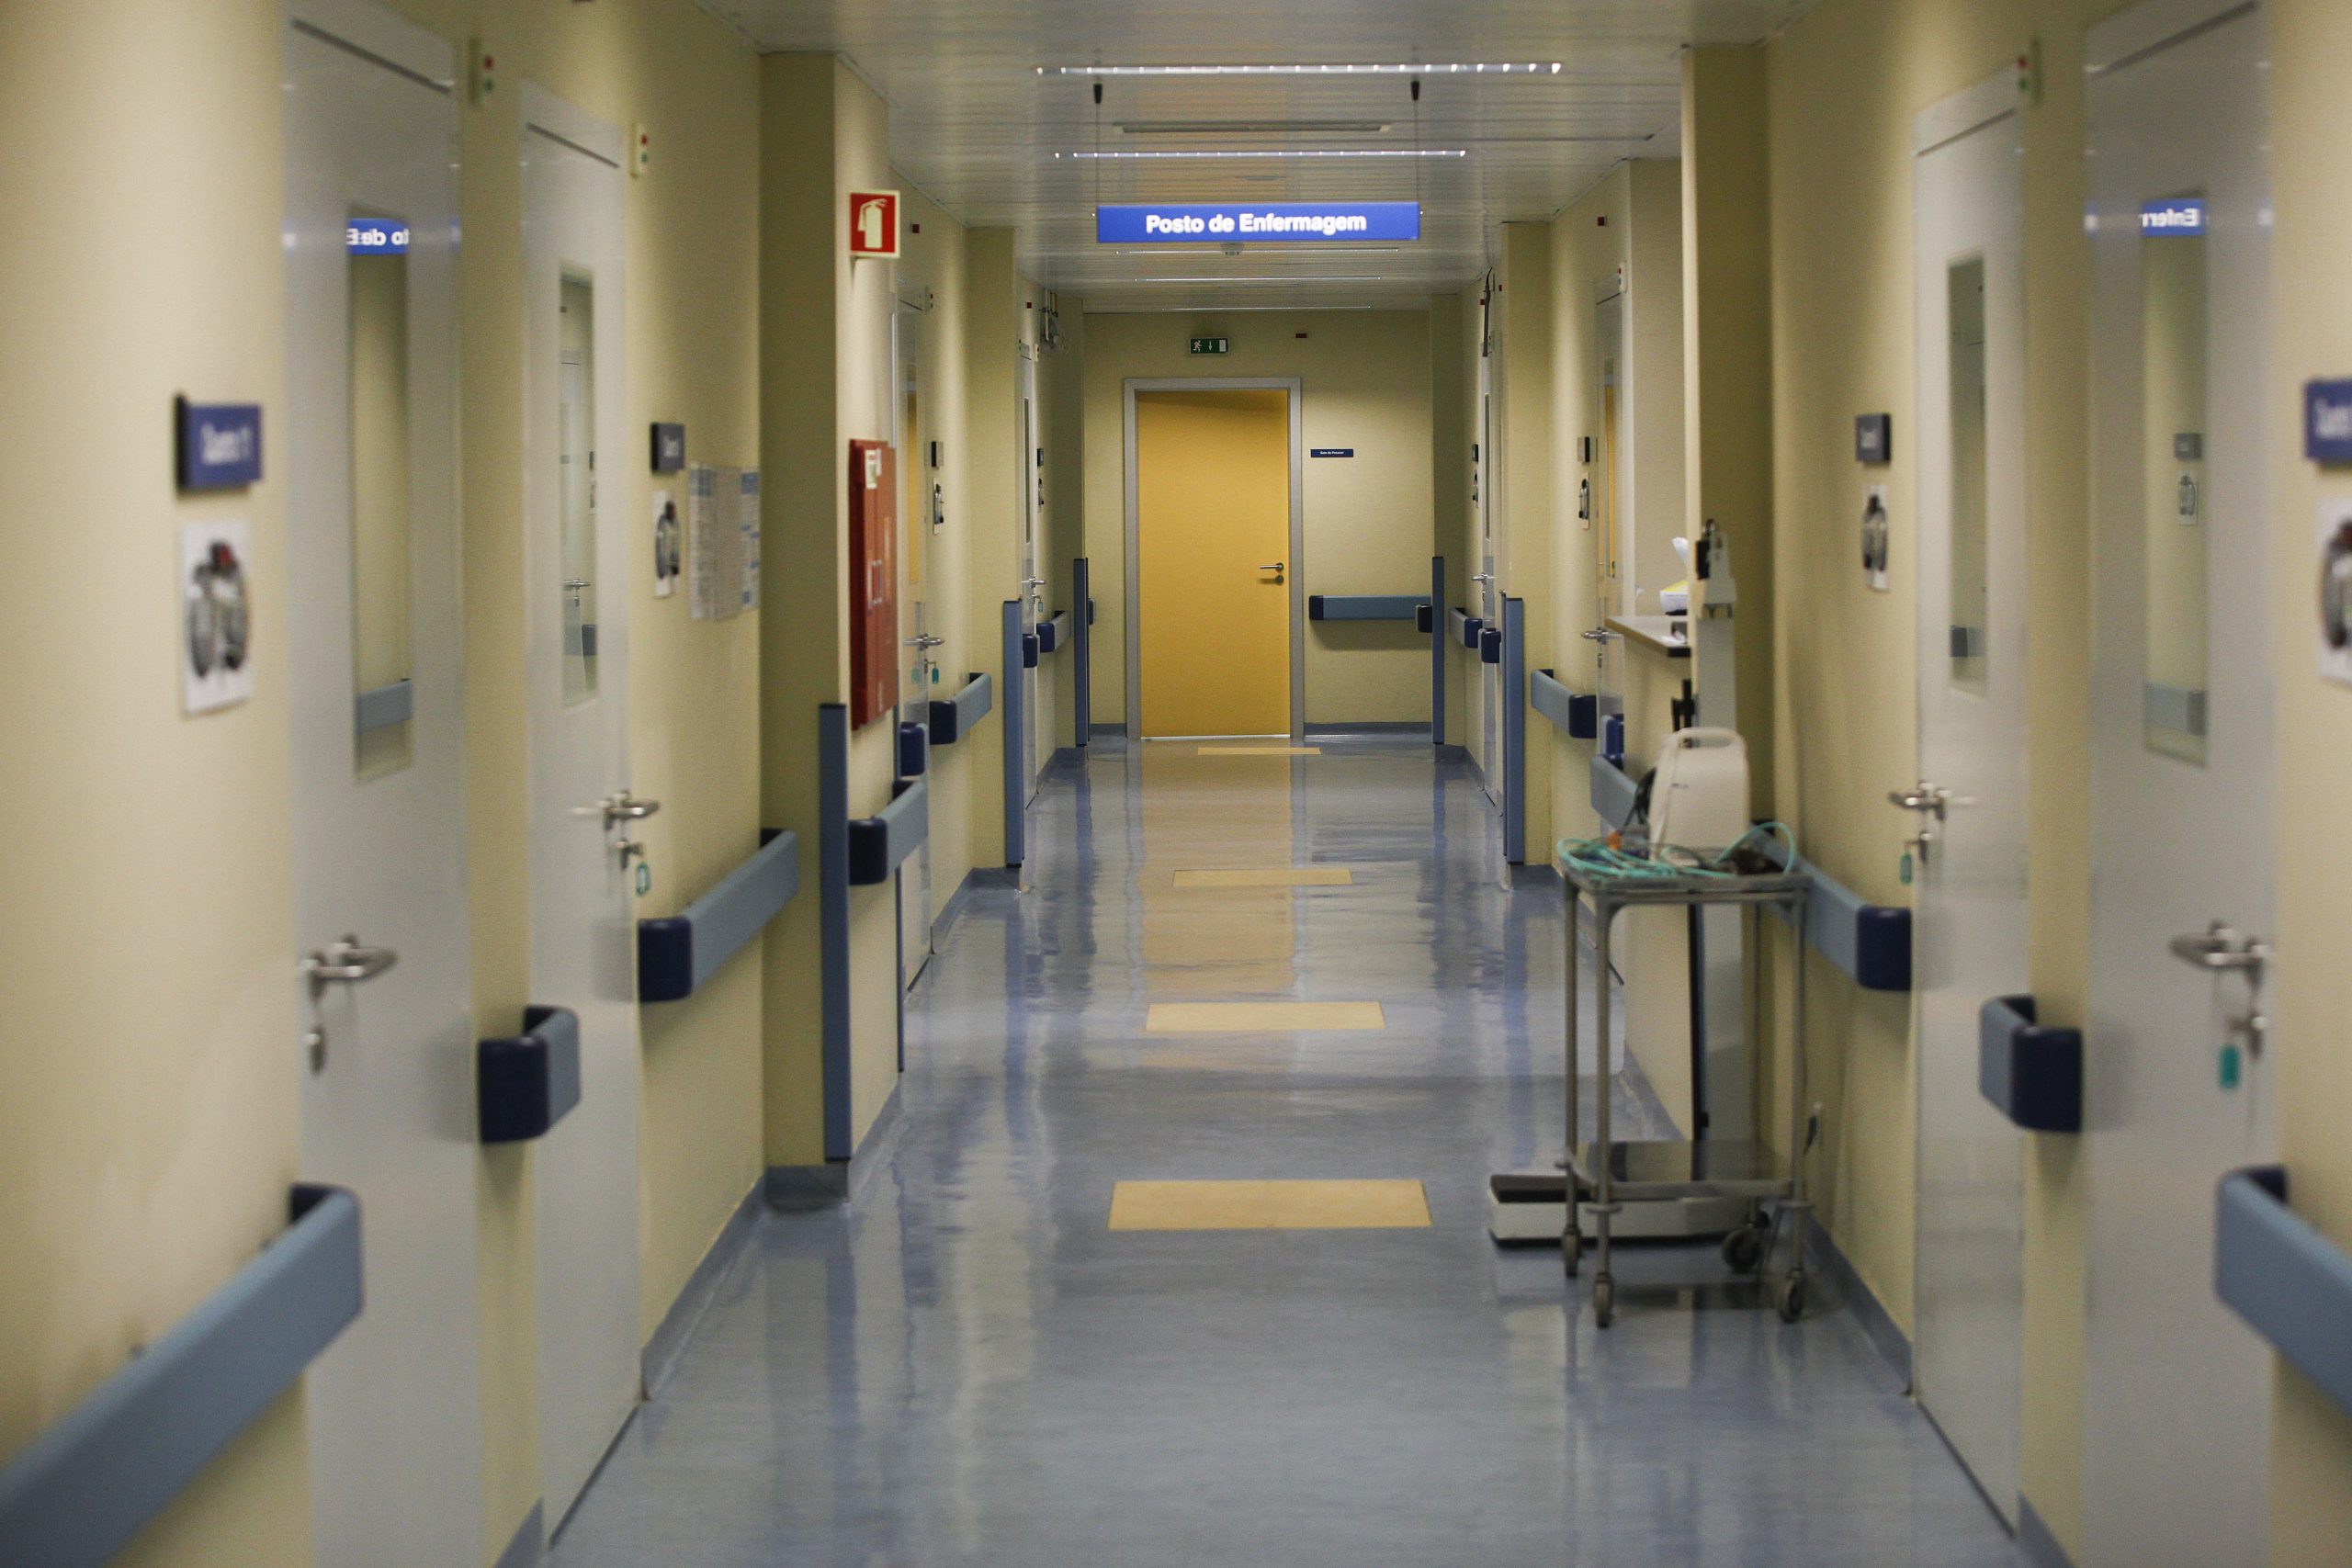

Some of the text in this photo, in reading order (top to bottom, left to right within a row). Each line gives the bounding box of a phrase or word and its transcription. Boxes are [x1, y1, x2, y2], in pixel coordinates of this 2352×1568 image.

[1146, 213, 1367, 235] Posto de Enfermagem
